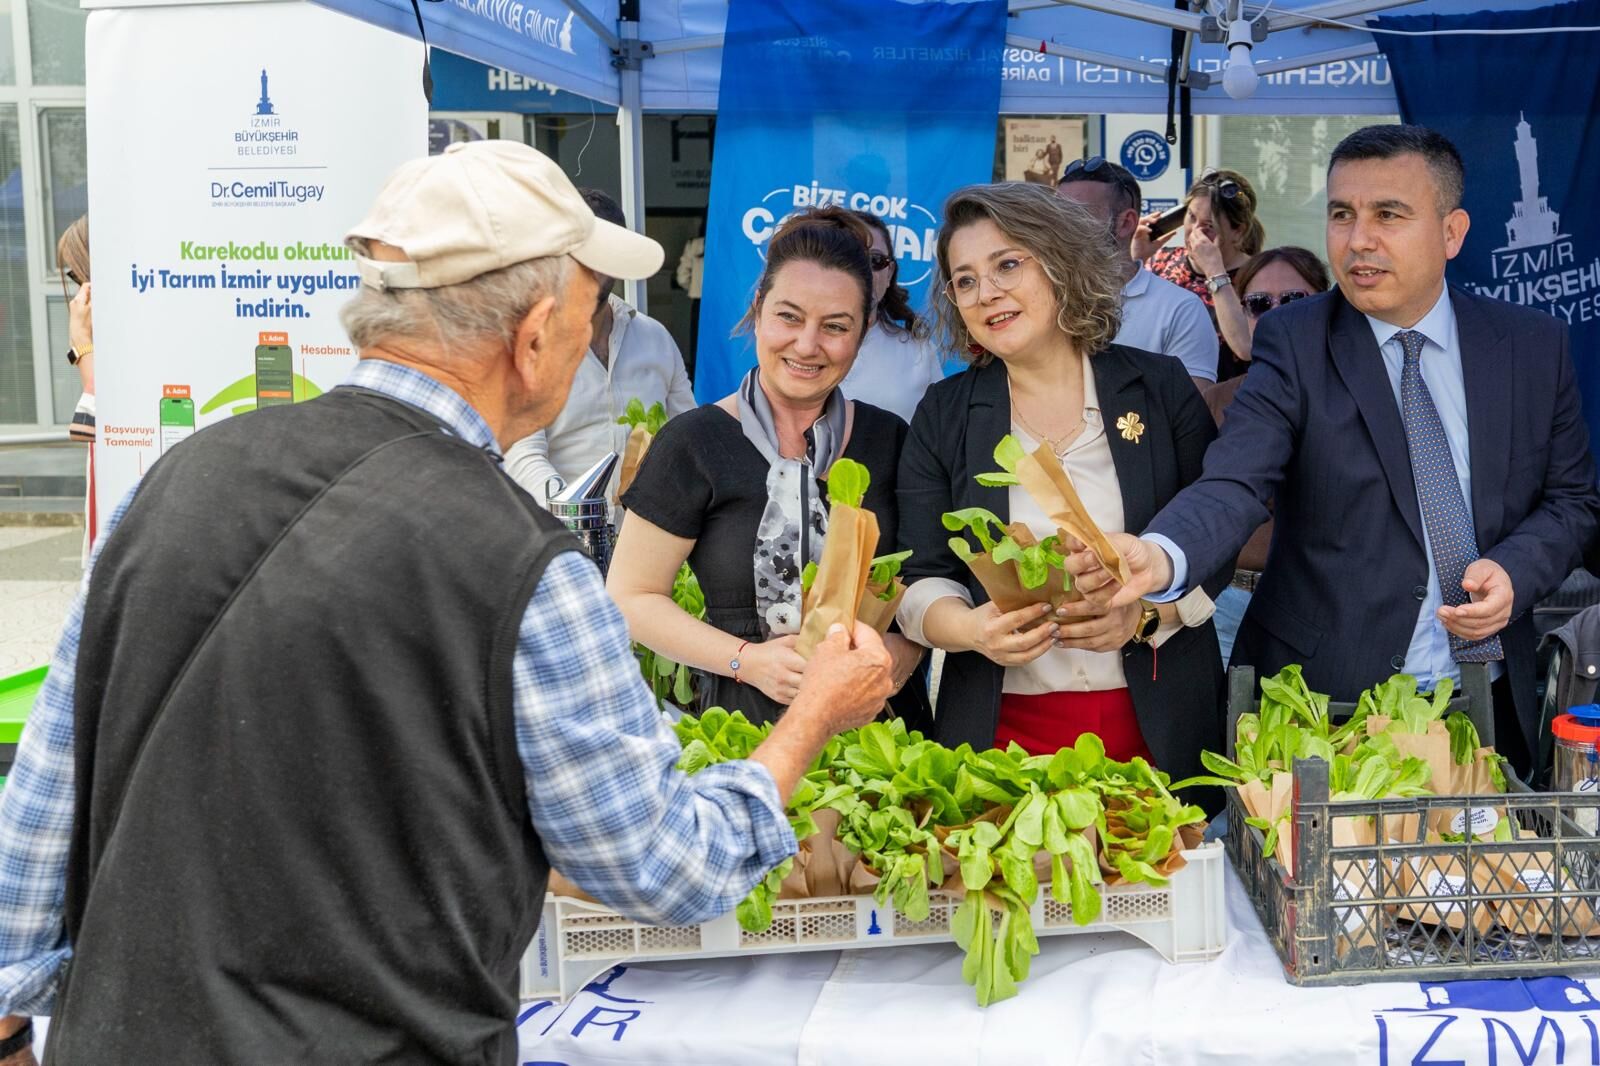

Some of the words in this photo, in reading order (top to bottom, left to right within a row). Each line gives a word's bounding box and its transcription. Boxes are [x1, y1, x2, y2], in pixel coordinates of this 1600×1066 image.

[251, 118, 281, 128] İZMİR
[234, 130, 299, 142] BÜYÜKŞEHİR
[237, 145, 297, 156] BELEDİYESİ
[793, 180, 847, 209] BİZE
[180, 241, 279, 261] Karekodu
[1491, 242, 1574, 280] İZMİR
[131, 264, 154, 293] İyi
[158, 269, 216, 289] Tarım
[221, 264, 272, 289] İzmir
[236, 298, 310, 318] indirin.
[301, 344, 351, 355] Hesabınız
[104, 425, 155, 436] Başvuruyu
[104, 438, 153, 447] Tamamla!
